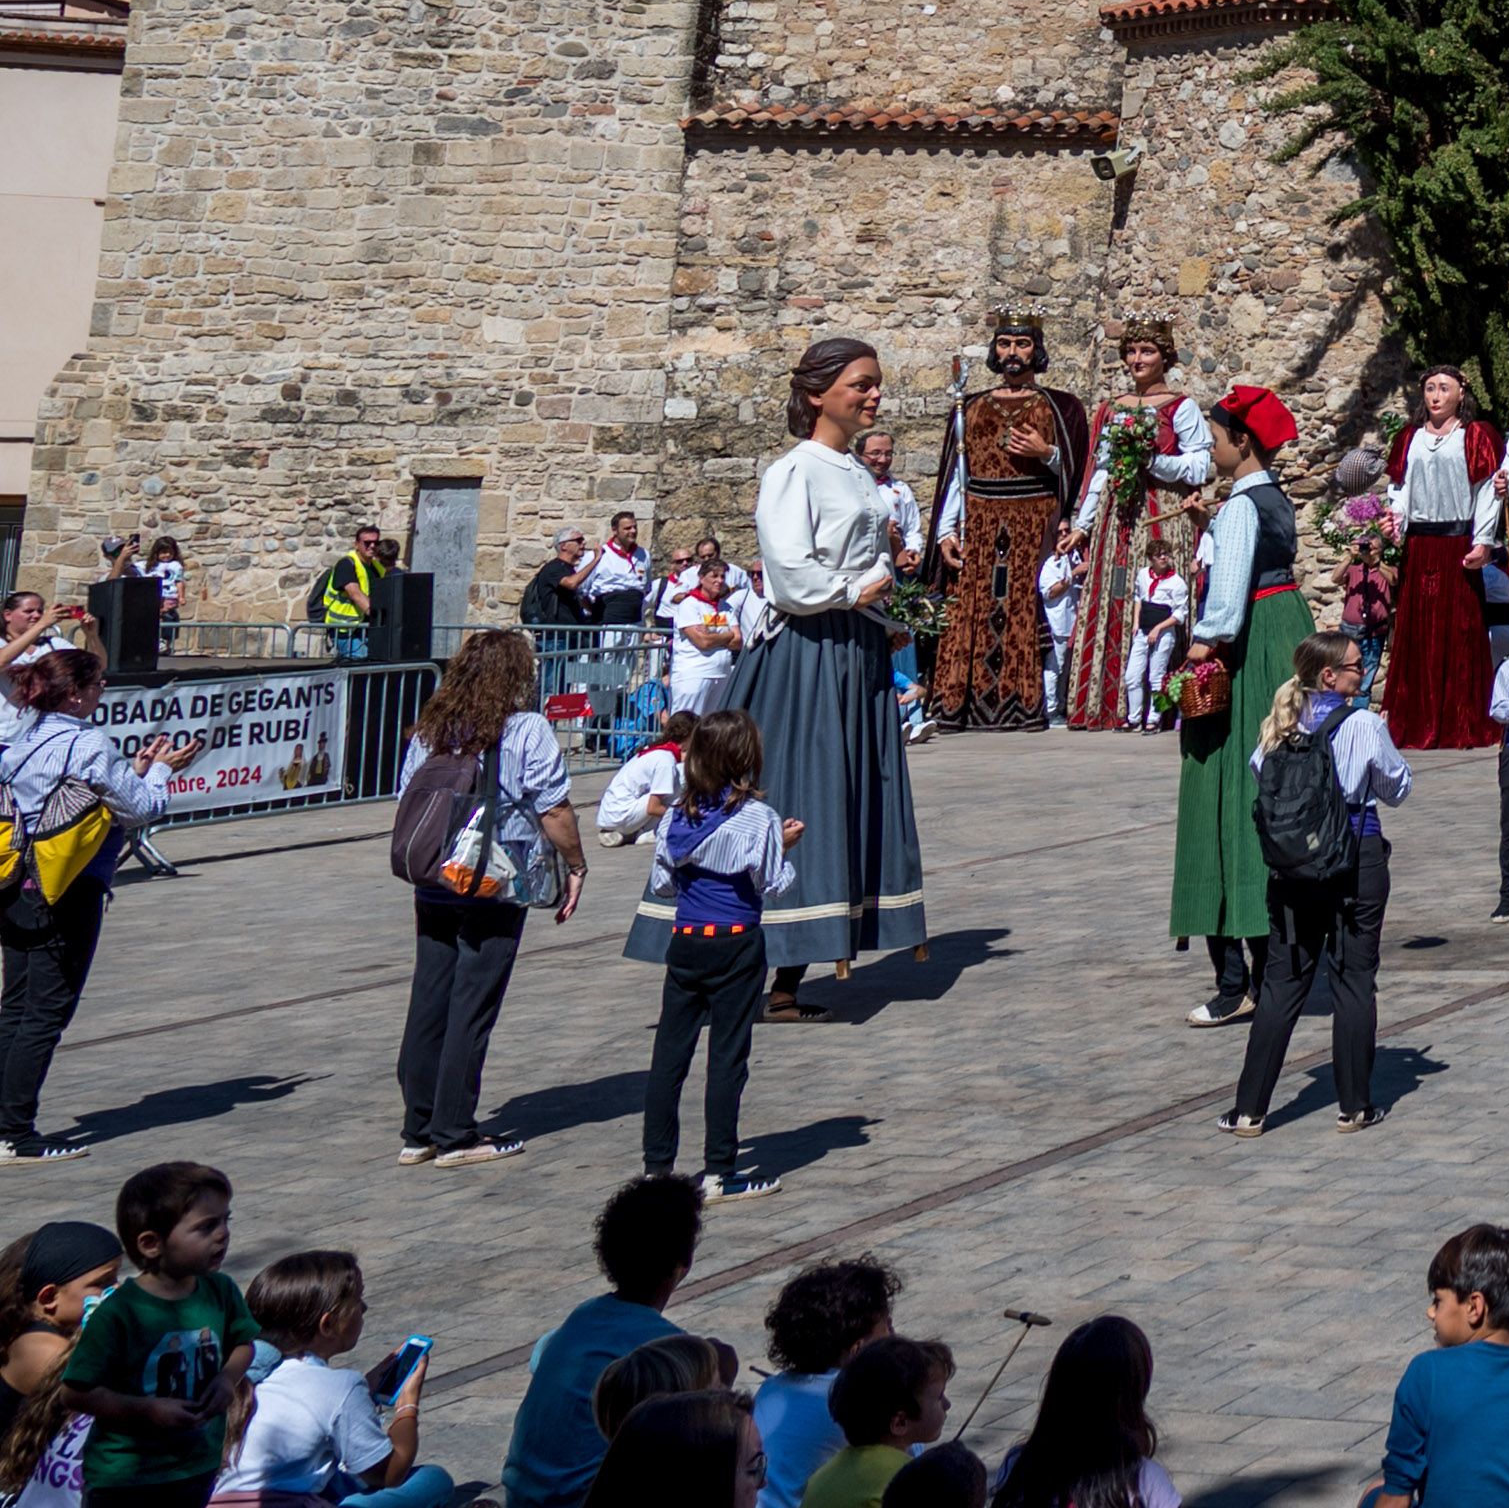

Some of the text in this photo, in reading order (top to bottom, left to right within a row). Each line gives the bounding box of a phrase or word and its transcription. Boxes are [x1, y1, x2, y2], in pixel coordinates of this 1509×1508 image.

[92, 682, 335, 727] OBADA DE GEGANTS
[211, 724, 242, 749] DE
[249, 711, 311, 745] RUBÍ
[216, 765, 262, 788] 2024
